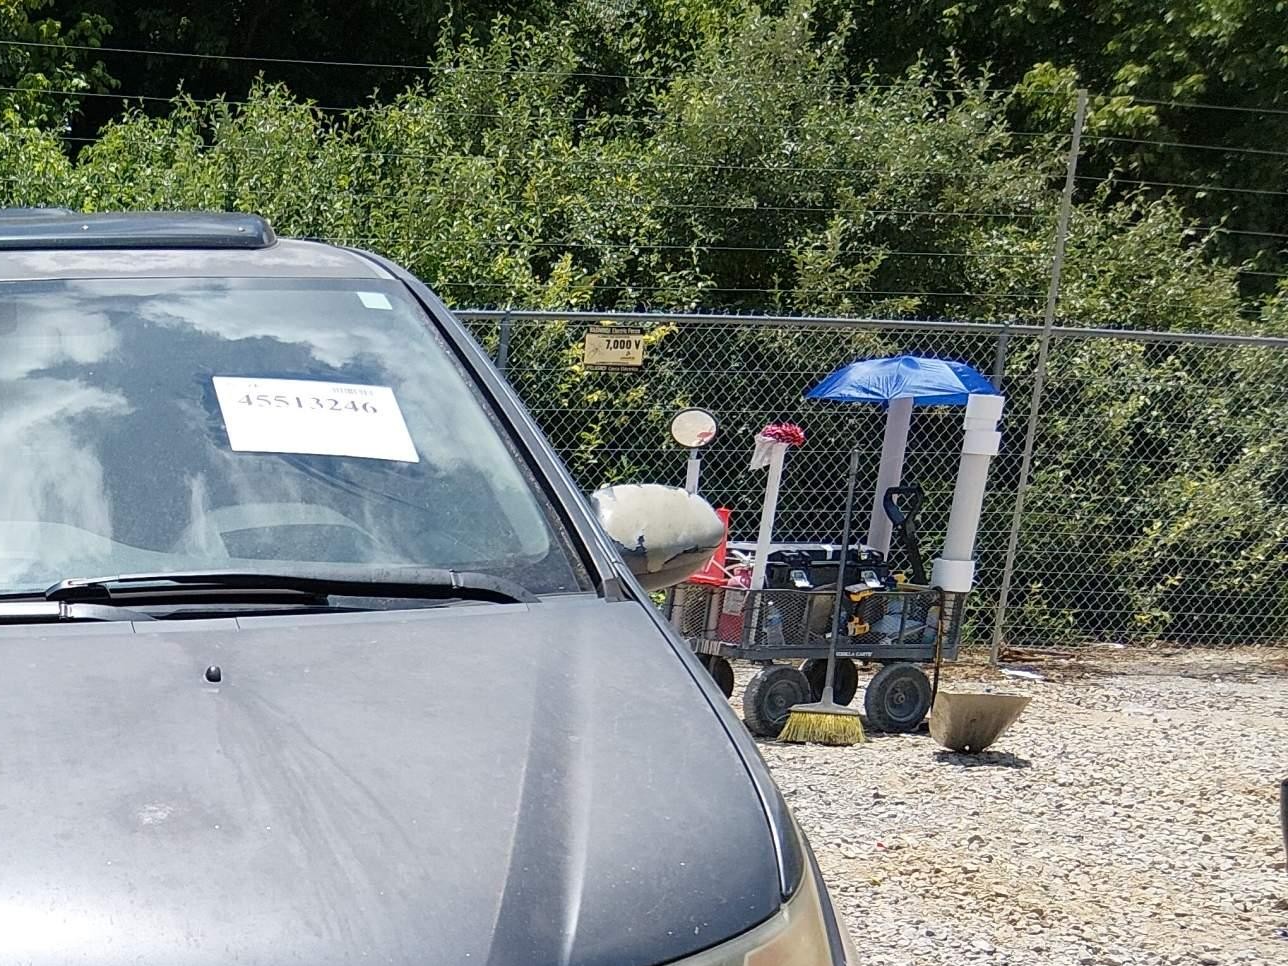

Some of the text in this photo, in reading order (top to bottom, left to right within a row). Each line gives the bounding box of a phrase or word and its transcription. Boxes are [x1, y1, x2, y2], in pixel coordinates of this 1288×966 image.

[605, 339, 641, 351] 7,000 V
[237, 394, 378, 414] 45513246
